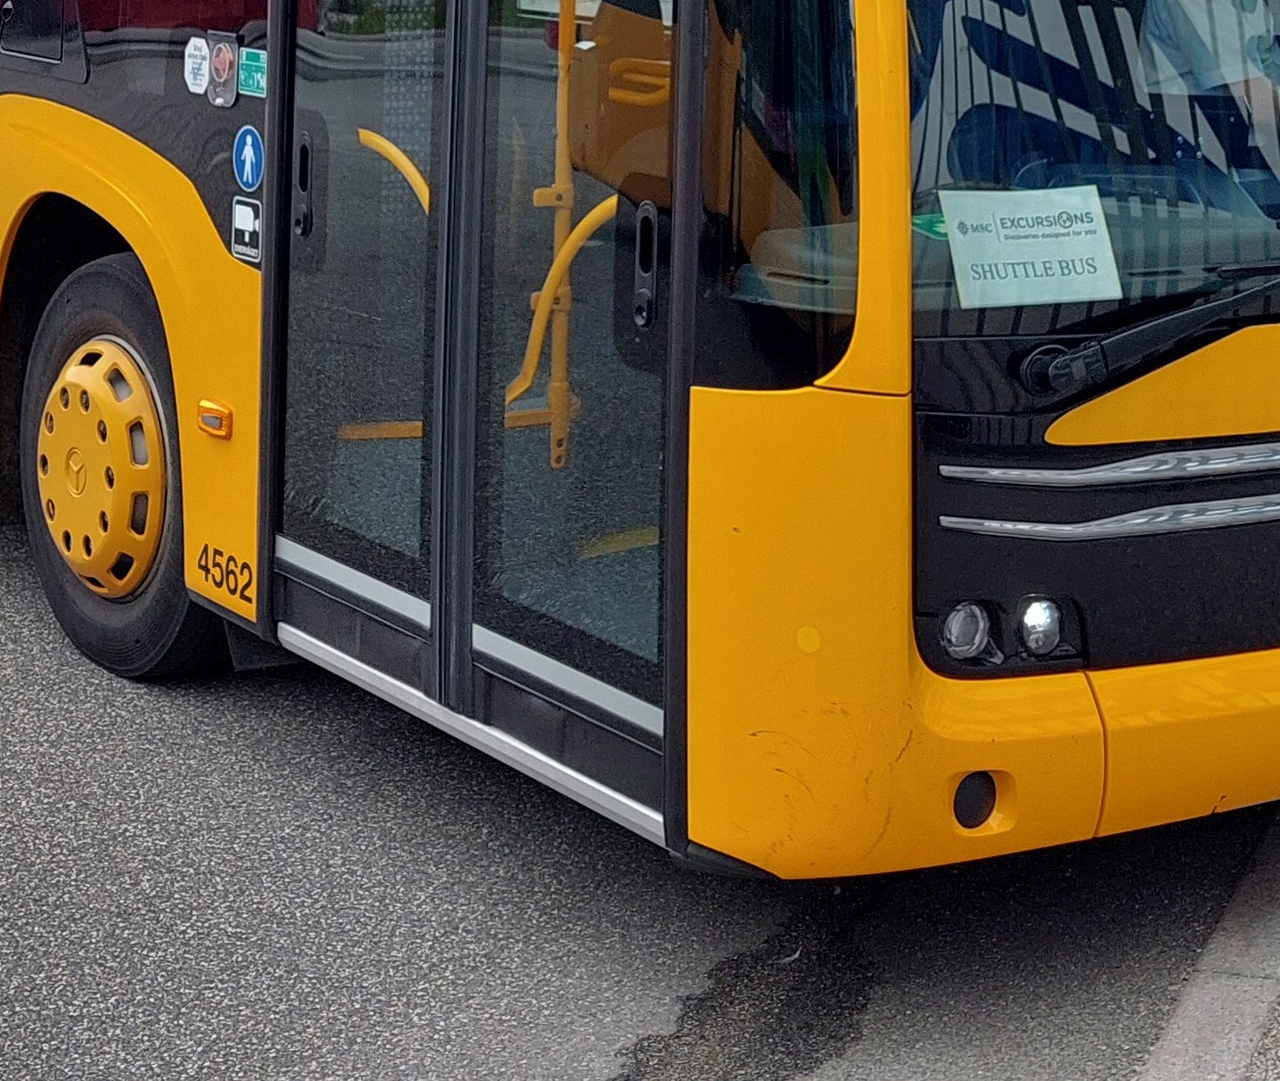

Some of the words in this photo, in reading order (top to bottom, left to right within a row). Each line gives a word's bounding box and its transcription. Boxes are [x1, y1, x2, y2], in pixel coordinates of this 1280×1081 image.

[969, 223, 994, 235] MSC
[970, 260, 1056, 281] SHUTTLE
[1059, 256, 1098, 276] BUS
[197, 542, 254, 605] 4562
